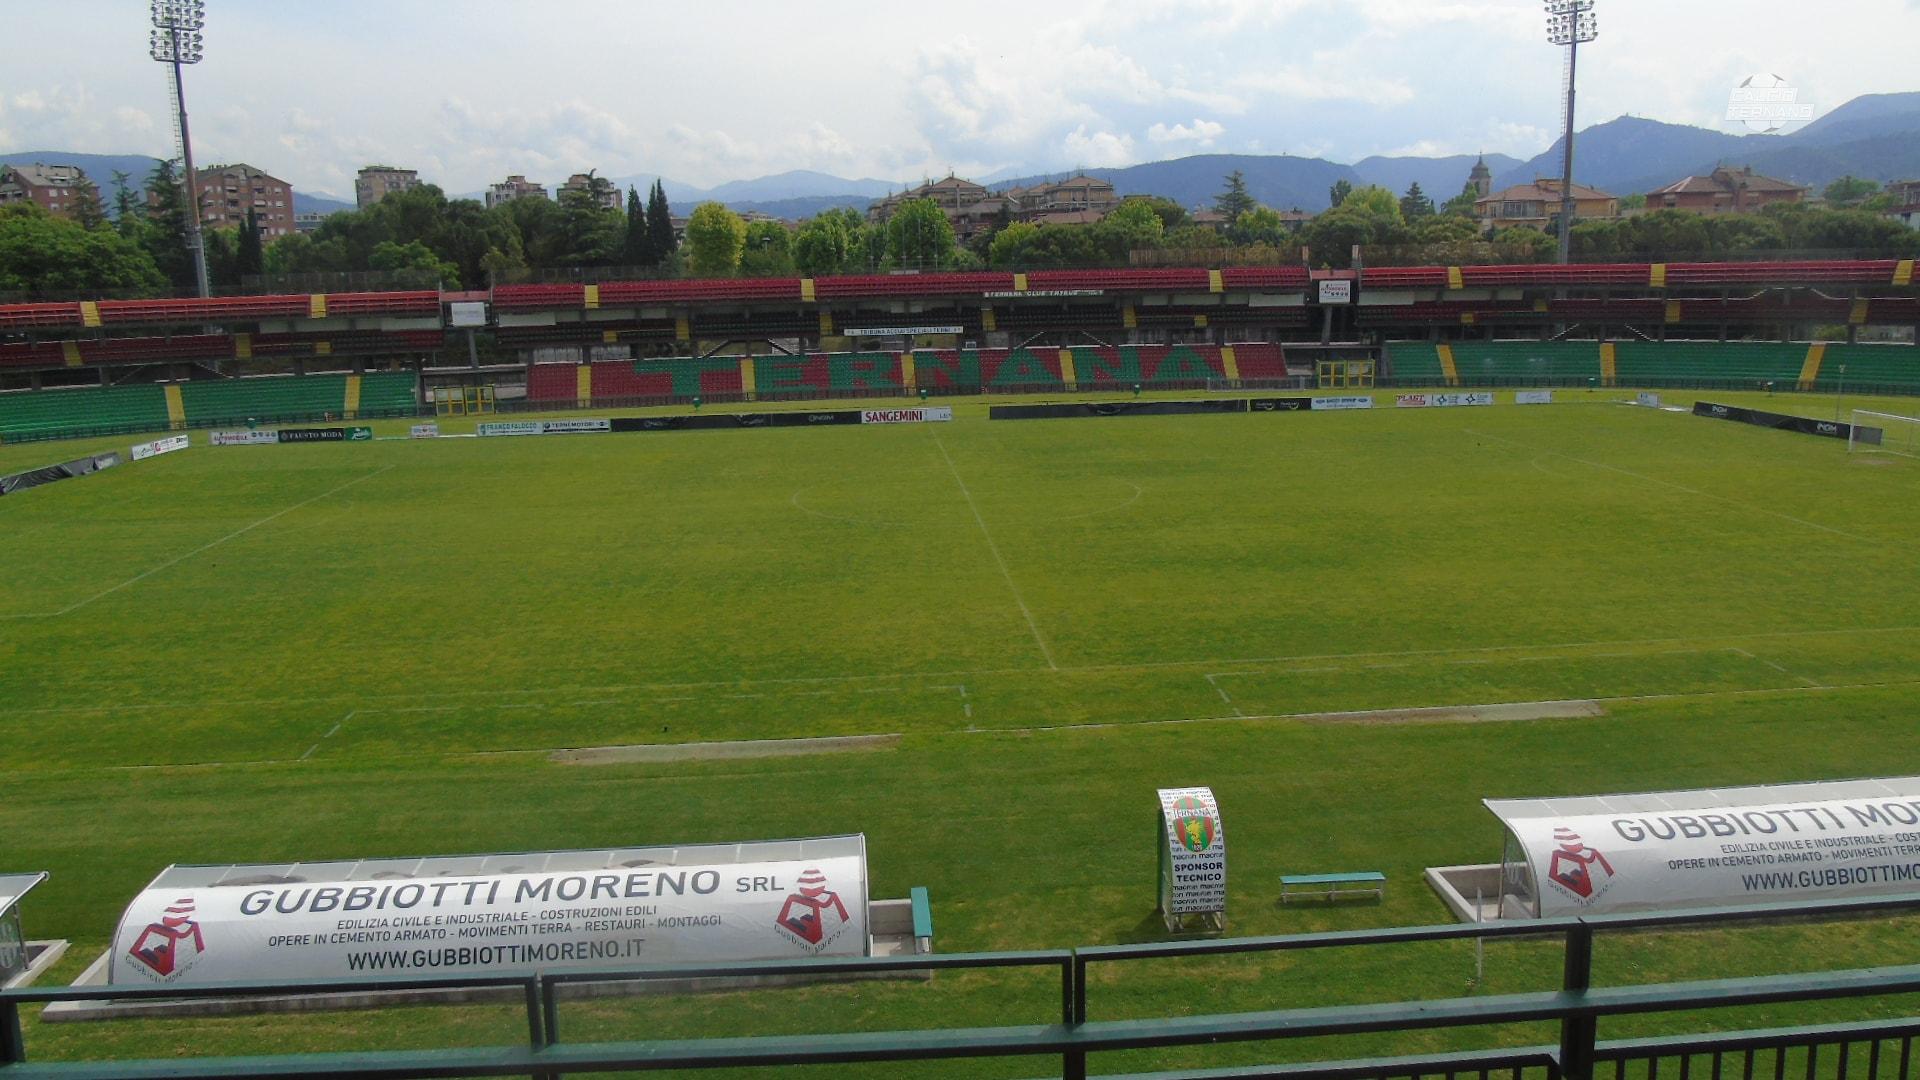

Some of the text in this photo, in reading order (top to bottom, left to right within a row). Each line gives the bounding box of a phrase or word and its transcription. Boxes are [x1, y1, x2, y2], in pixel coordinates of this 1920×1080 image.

[632, 344, 1222, 396] TERNANA
[865, 410, 923, 422] SANGEMINI
[289, 431, 319, 439] FAUSTO
[1173, 808, 1212, 818] TERNANA
[1610, 807, 1846, 842] GUBBIOTTI
[1720, 842, 1767, 854] EDILIZIA
[1769, 840, 1803, 851] CIVILE
[1806, 839, 1812, 848] E
[1815, 834, 1886, 849] INDUSTRIALE
[1174, 862, 1223, 872] SPONSOR
[1668, 858, 1705, 870] OPERE
[1708, 857, 1720, 868] IN
[1722, 853, 1775, 867] CEMENTO
[1777, 851, 1823, 864] ARMATO
[1832, 847, 1893, 860] MOVIMENTI
[1176, 873, 1221, 882] TECNICO
[239, 870, 785, 915] GUBBIOTTI MORENO SRL
[337, 905, 657, 930] EDILIZIA CIVILE E INDUSTRIALE COSTRUZIONI EDILI
[268, 914, 722, 947] OPERE IN CEMENTO ARMATO MOVIMENTI TERRA RESTAURI MONTAGGI
[347, 938, 646, 971] WWW.GUBBIOTTIMORENO.IT
